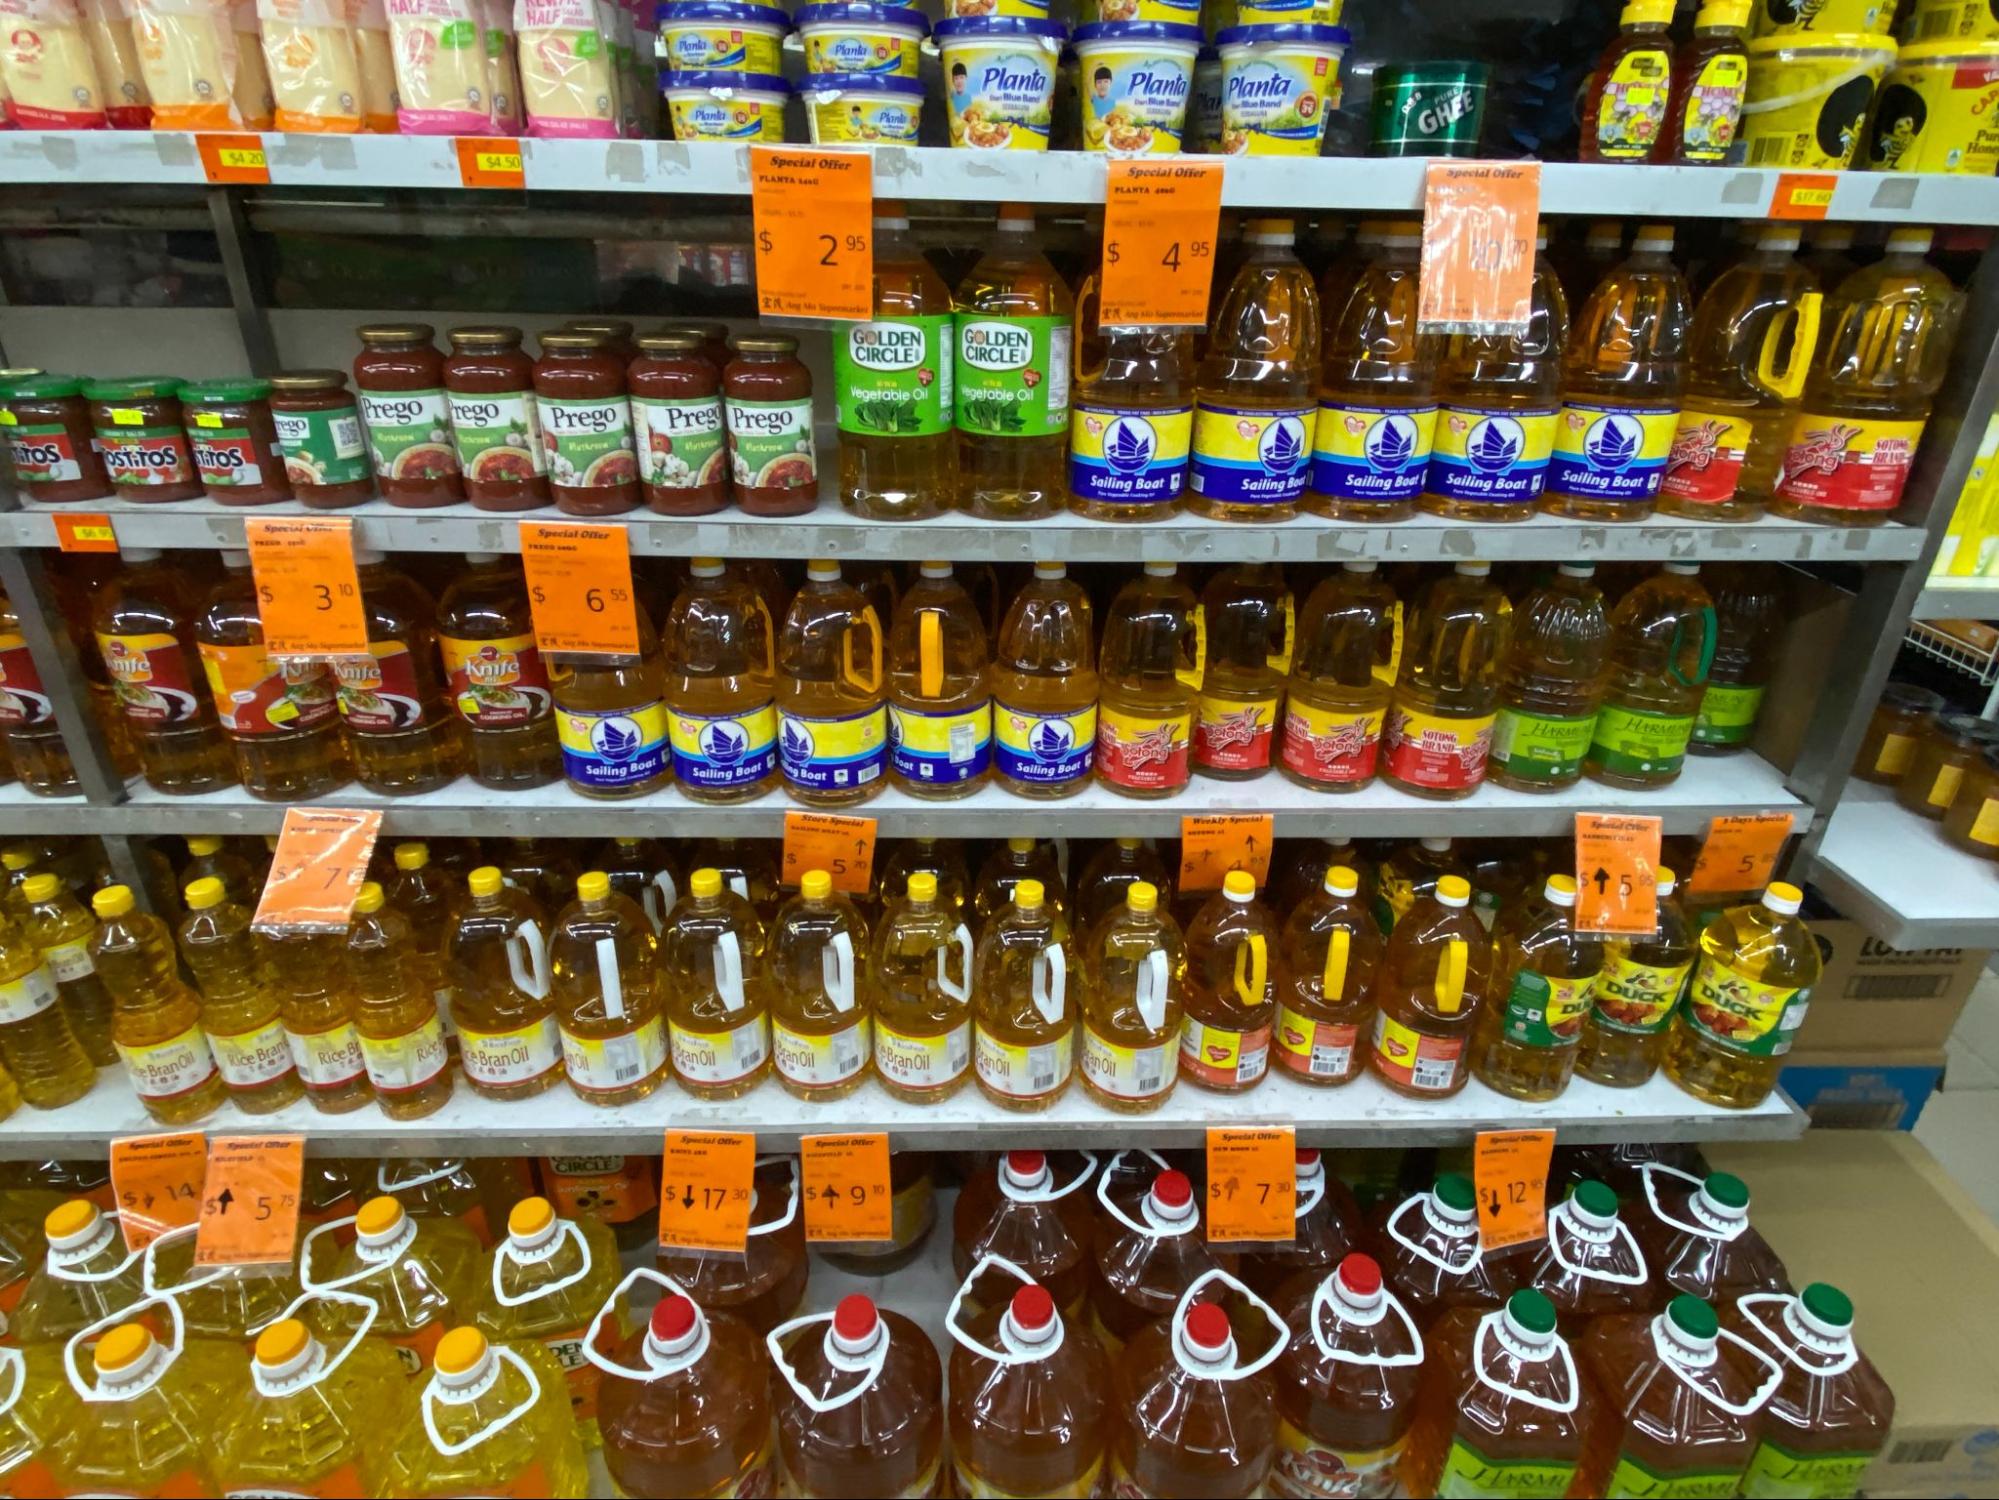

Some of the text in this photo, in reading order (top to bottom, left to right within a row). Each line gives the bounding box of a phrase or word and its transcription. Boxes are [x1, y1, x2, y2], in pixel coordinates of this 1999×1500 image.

[527, 10, 561, 26] HALF
[679, 38, 707, 52] Planta
[835, 44, 868, 57] Planta
[982, 67, 1046, 92] Planta
[1128, 71, 1188, 97] Planta
[1228, 72, 1293, 98] Planta
[695, 110, 726, 122] Planta
[1418, 90, 1474, 134] GHEE
[229, 152, 265, 166] $4.20
[486, 156, 521, 168] $4.50
[770, 156, 851, 171] Special Offer
[1127, 167, 1206, 178] Special Offer
[1447, 169, 1523, 179] Special Offer
[759, 229, 866, 266] $ 2 95
[1107, 241, 1210, 273] $ 4 95
[853, 328, 921, 347] GOLDEN
[964, 328, 1028, 347] GOLDEN
[855, 346, 914, 363] CIRCLE
[966, 346, 1020, 363] CIRCLE
[850, 385, 929, 402] Vegetable Oil
[961, 385, 1035, 402] Vegetable Oil
[361, 397, 423, 425] Prego
[551, 406, 617, 433] Prego
[666, 404, 721, 431] Prego
[276, 418, 307, 438] rego
[733, 407, 793, 435] Prego
[1090, 475, 1165, 492] Sailing Boat
[1241, 475, 1306, 493] Sailing Boat
[1345, 474, 1420, 490] Sailing Boat
[1446, 473, 1527, 492] Sailing Boat
[1562, 469, 1644, 489] Sailing Boat
[537, 528, 578, 539] Special
[260, 584, 354, 611] $ 3 10
[532, 584, 628, 613] $ 6 55
[465, 659, 520, 677] Knife
[1422, 729, 1457, 743] SOTONG
[1422, 740, 1455, 752] BRAND
[585, 764, 628, 778] Sailing
[630, 757, 657, 773] Boat
[692, 766, 733, 781] Sailing
[735, 761, 762, 777] Boat
[800, 767, 827, 781] Boat
[1016, 760, 1082, 778] Sailing Boat
[1730, 813, 1788, 826] Days Special
[832, 858, 847, 874] 5
[1737, 855, 1753, 873] 5
[326, 867, 342, 890] 7
[1620, 874, 1633, 896] 5
[1606, 981, 1667, 1004] DUCK
[1701, 986, 1762, 1021] DUCK
[178, 1051, 195, 1068] Oil
[226, 1049, 256, 1067] Rice
[318, 1048, 347, 1065] Rice
[478, 1045, 530, 1068] Bran Oil
[574, 1053, 589, 1072] Oil
[699, 1050, 716, 1067] Oil
[799, 1049, 815, 1069] Oil
[886, 1046, 931, 1071] Bran Oil
[996, 1057, 1011, 1076] Oil
[1102, 1060, 1116, 1077] Oil
[681, 1135, 716, 1146] Special
[815, 1138, 876, 1149] Special Offer
[1222, 1133, 1256, 1142] Special
[555, 1159, 610, 1173] CIRCLE
[665, 1186, 749, 1211] $ 17 30
[806, 1184, 885, 1206] $ 9 10
[1211, 1182, 1221, 1199] $
[1256, 1183, 1271, 1205] 7
[1507, 1181, 1526, 1205] 12
[255, 1196, 272, 1221] 5
[281, 1194, 295, 1208] 75
